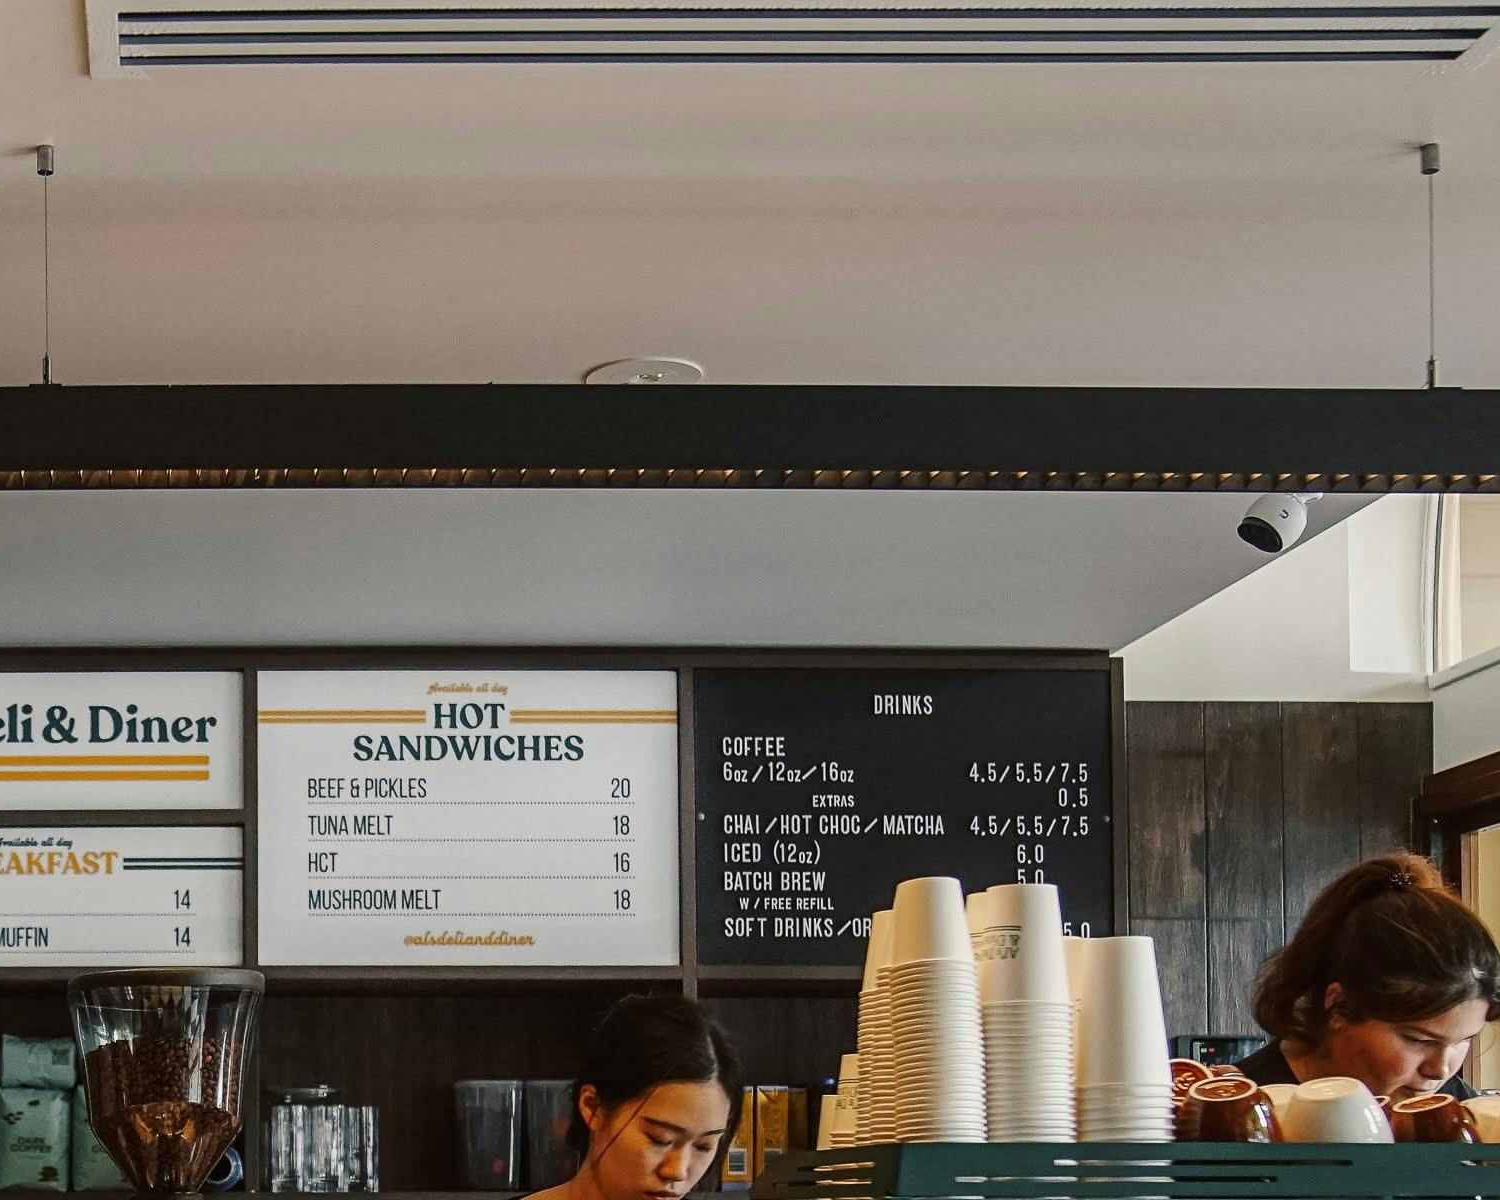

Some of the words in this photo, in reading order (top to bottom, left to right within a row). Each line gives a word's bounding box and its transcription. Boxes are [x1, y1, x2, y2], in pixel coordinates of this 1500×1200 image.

[427, 682, 473, 695] Available
[476, 682, 489, 693] all
[491, 682, 508, 695] day
[874, 694, 933, 715] DRINKS
[42, 705, 78, 743] &
[88, 704, 218, 743] Diner
[433, 703, 506, 729] HOT
[353, 735, 585, 762] SANDWICHES
[722, 736, 786, 757] COFFEE
[307, 778, 346, 798] BEEF
[350, 778, 360, 798] &
[365, 778, 427, 798] PICKLES
[611, 778, 631, 798] 20
[1058, 788, 1088, 808] 0.5
[812, 794, 855, 808] EXTRAS
[308, 815, 349, 835] TUNA
[353, 815, 393, 835] MELT
[613, 815, 630, 835] 18
[41, 837, 54, 847] all
[56, 837, 73, 850] day
[723, 842, 762, 863] ICED
[308, 852, 338, 872] HCT
[613, 852, 630, 872] 16
[1016, 844, 1044, 865] 6.0
[723, 871, 773, 892] BATCH
[780, 871, 826, 892] BREW
[173, 889, 191, 910] 14
[308, 889, 397, 910] MUSHROOM
[401, 889, 441, 910] MELT
[613, 889, 631, 910] 18
[796, 897, 834, 911] REFILL
[173, 927, 191, 947] 14
[724, 918, 767, 938] SOFT
